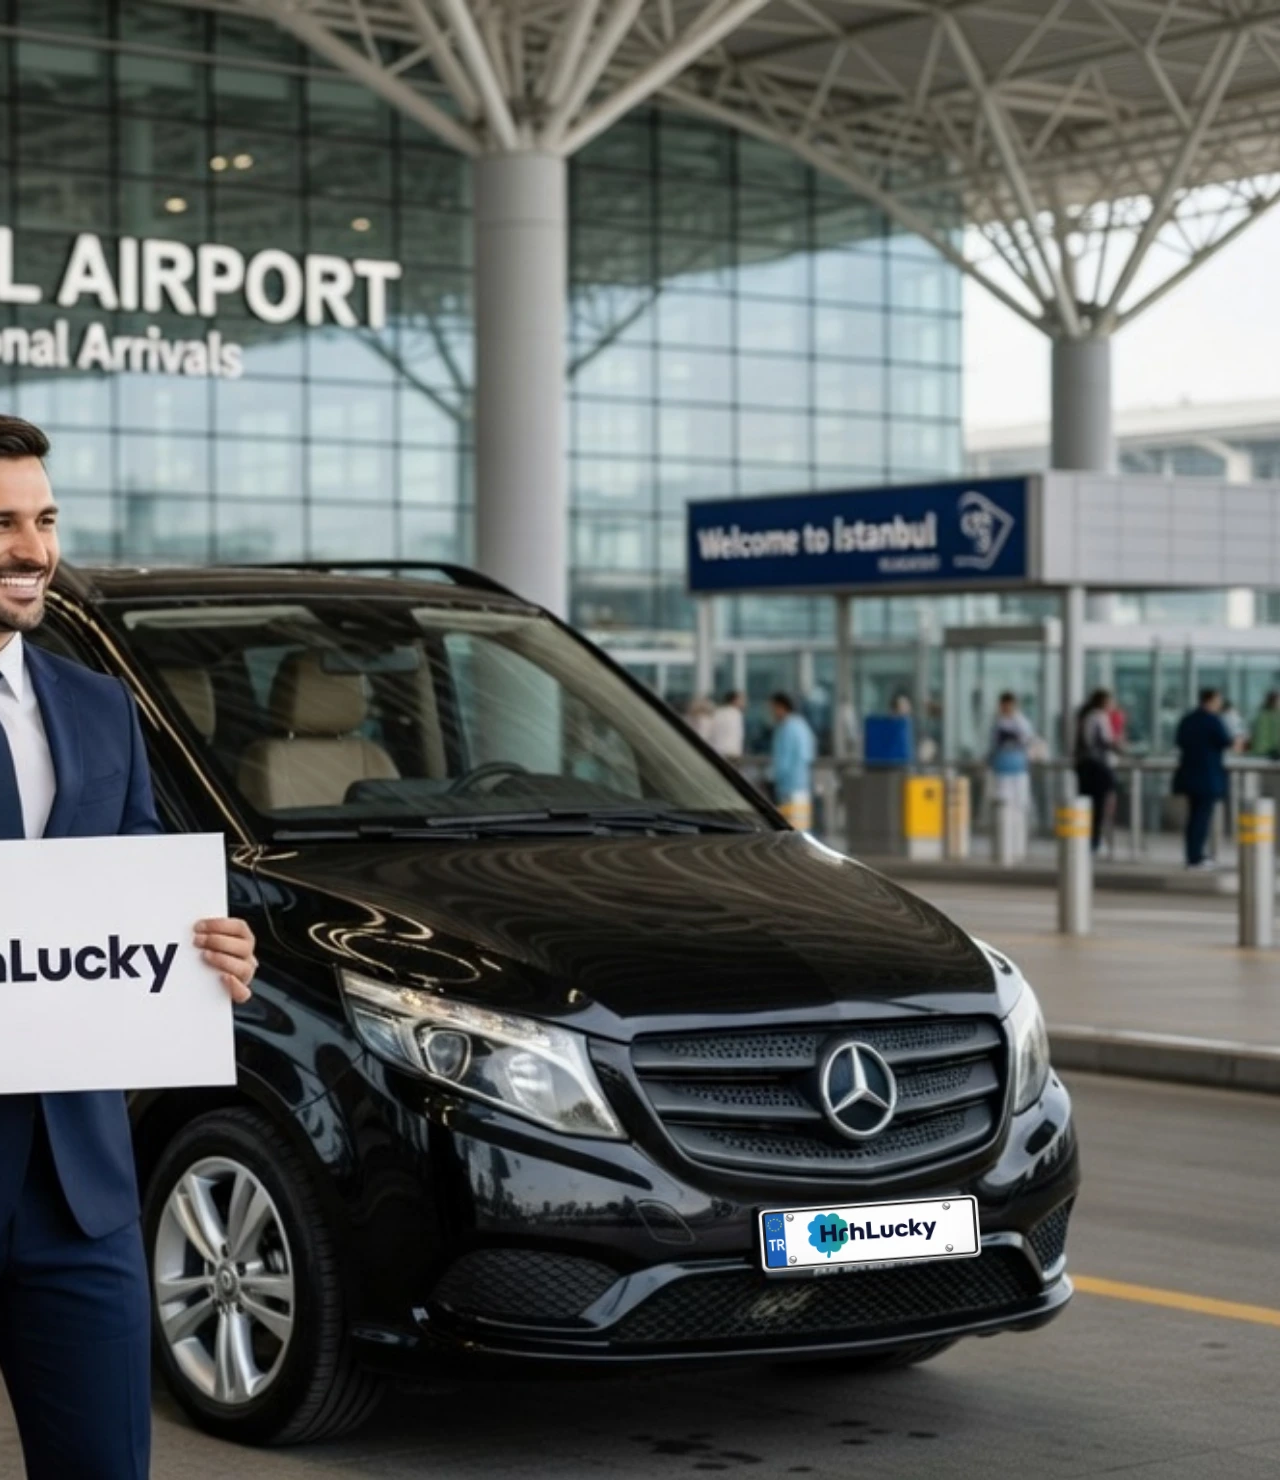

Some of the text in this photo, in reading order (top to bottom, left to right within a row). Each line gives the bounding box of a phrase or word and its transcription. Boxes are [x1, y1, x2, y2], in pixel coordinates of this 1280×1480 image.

[57, 232, 403, 329] AIRPORT
[77, 321, 244, 378] Arrivals
[697, 525, 799, 560] Welcome
[803, 522, 830, 555] to
[768, 1238, 786, 1252] TR
[819, 1218, 937, 1242] HrhLucky
